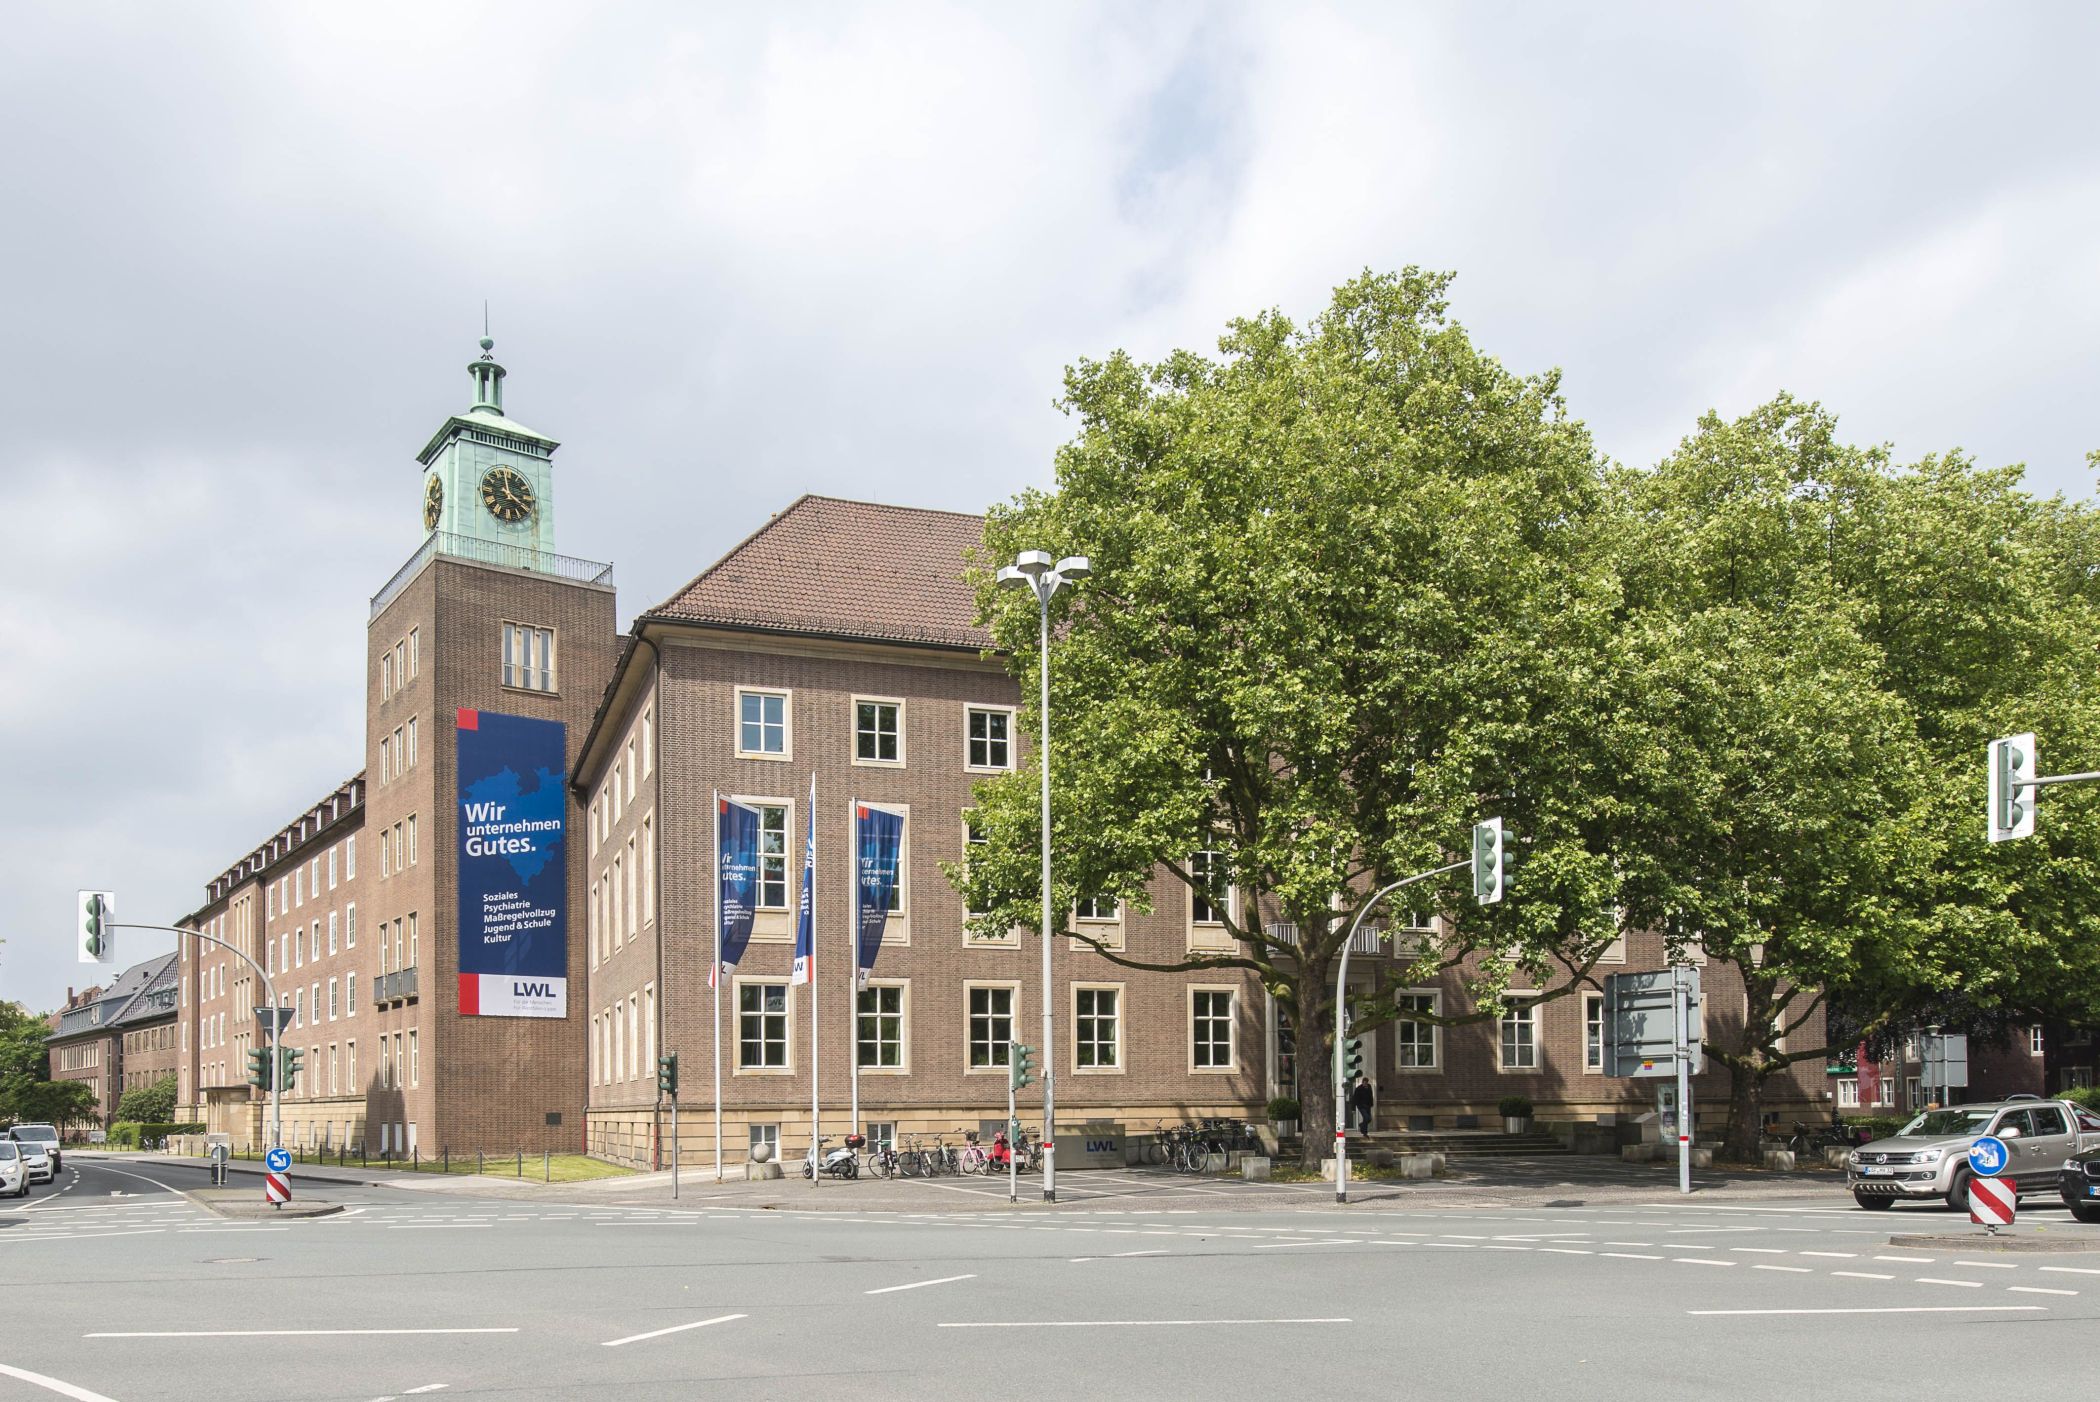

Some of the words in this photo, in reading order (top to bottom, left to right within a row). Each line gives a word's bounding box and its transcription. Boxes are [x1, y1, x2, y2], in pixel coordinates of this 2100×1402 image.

[464, 801, 506, 823] Wir
[466, 819, 561, 836] unternehmen
[465, 836, 537, 857] Gutes.
[722, 871, 747, 881] utes.
[483, 891, 518, 902] Soziales
[483, 900, 531, 914] Psychiatrie
[483, 909, 556, 923] Maßregelvollzug
[483, 922, 515, 934] Jugend
[516, 922, 523, 930] &
[523, 918, 552, 929] Schule
[483, 934, 512, 944] Kultur
[513, 982, 557, 998] LWL
[1086, 1140, 1117, 1153] LWL
